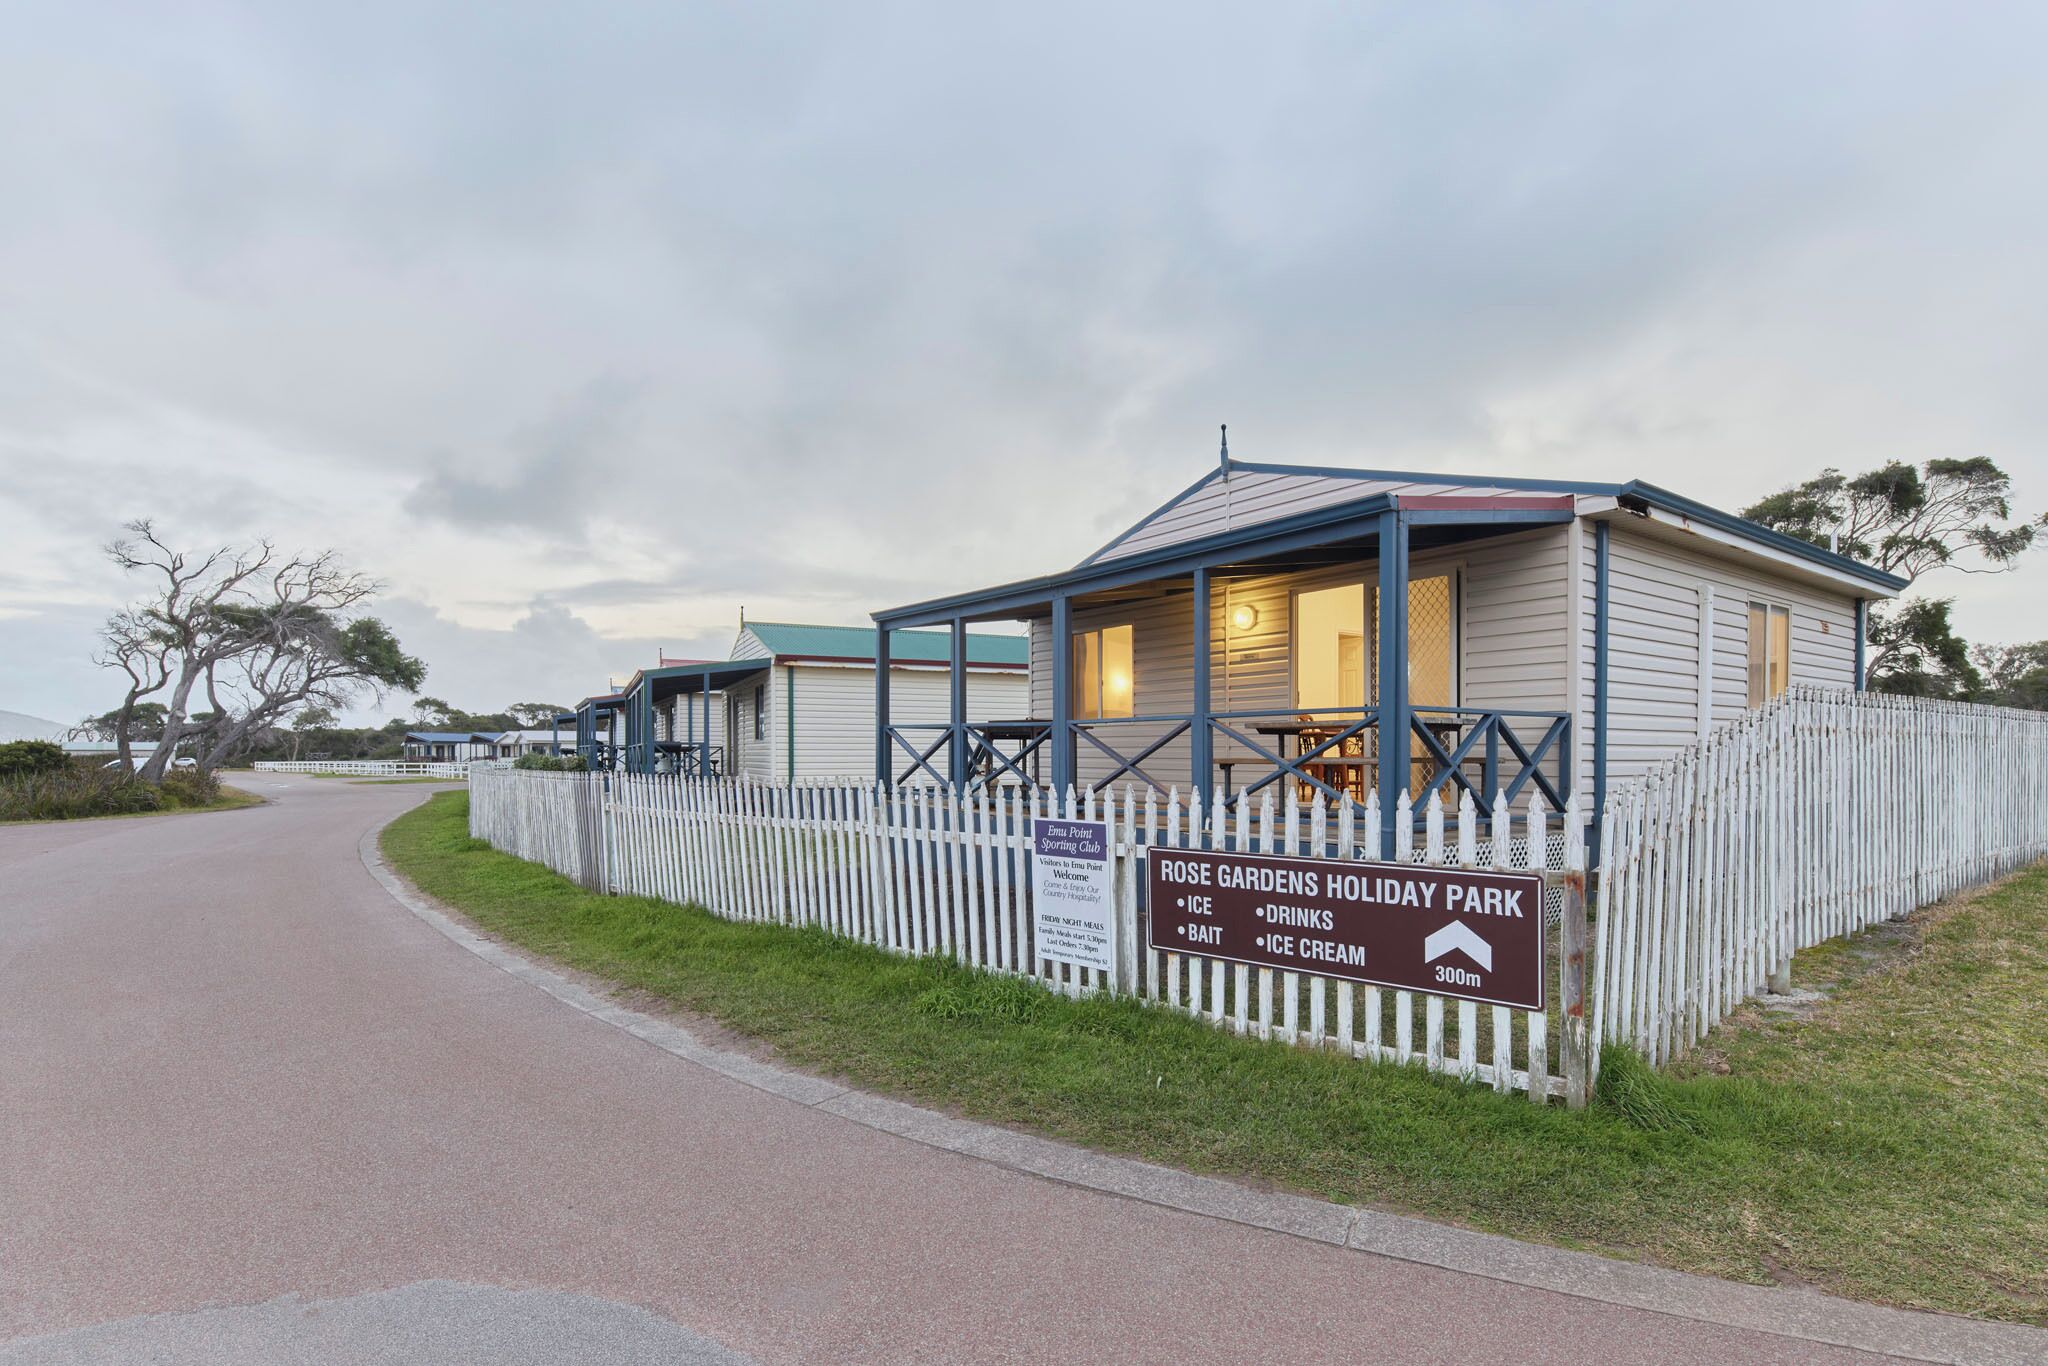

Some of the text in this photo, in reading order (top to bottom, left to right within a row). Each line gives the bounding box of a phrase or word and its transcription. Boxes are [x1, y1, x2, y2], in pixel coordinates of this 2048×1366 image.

[1048, 825, 1093, 839] Emu Point
[1041, 837, 1100, 855] Sporting Club
[1040, 858, 1103, 871] Visitors to Emu Point
[1053, 869, 1089, 882] Welcome
[1043, 888, 1101, 904] Country Hospitality!
[1044, 880, 1100, 894] Come & Enjoy Our
[1161, 860, 1524, 918] ROSE GARDENS HOLIDAY PARK
[1188, 895, 1212, 916] ICE
[1041, 914, 1104, 931] FRIDAY NIGHT MEALS
[1266, 903, 1334, 931] DRINKS
[1039, 926, 1055, 935] Family
[1057, 929, 1072, 938] Meals
[1087, 935, 1107, 945] 5.30pm
[1188, 923, 1223, 945] BAIT
[1059, 940, 1077, 949] Orders
[1078, 943, 1099, 954] 7.30pm
[1266, 933, 1366, 967] ICE CREAM
[1435, 965, 1481, 988] 300m
